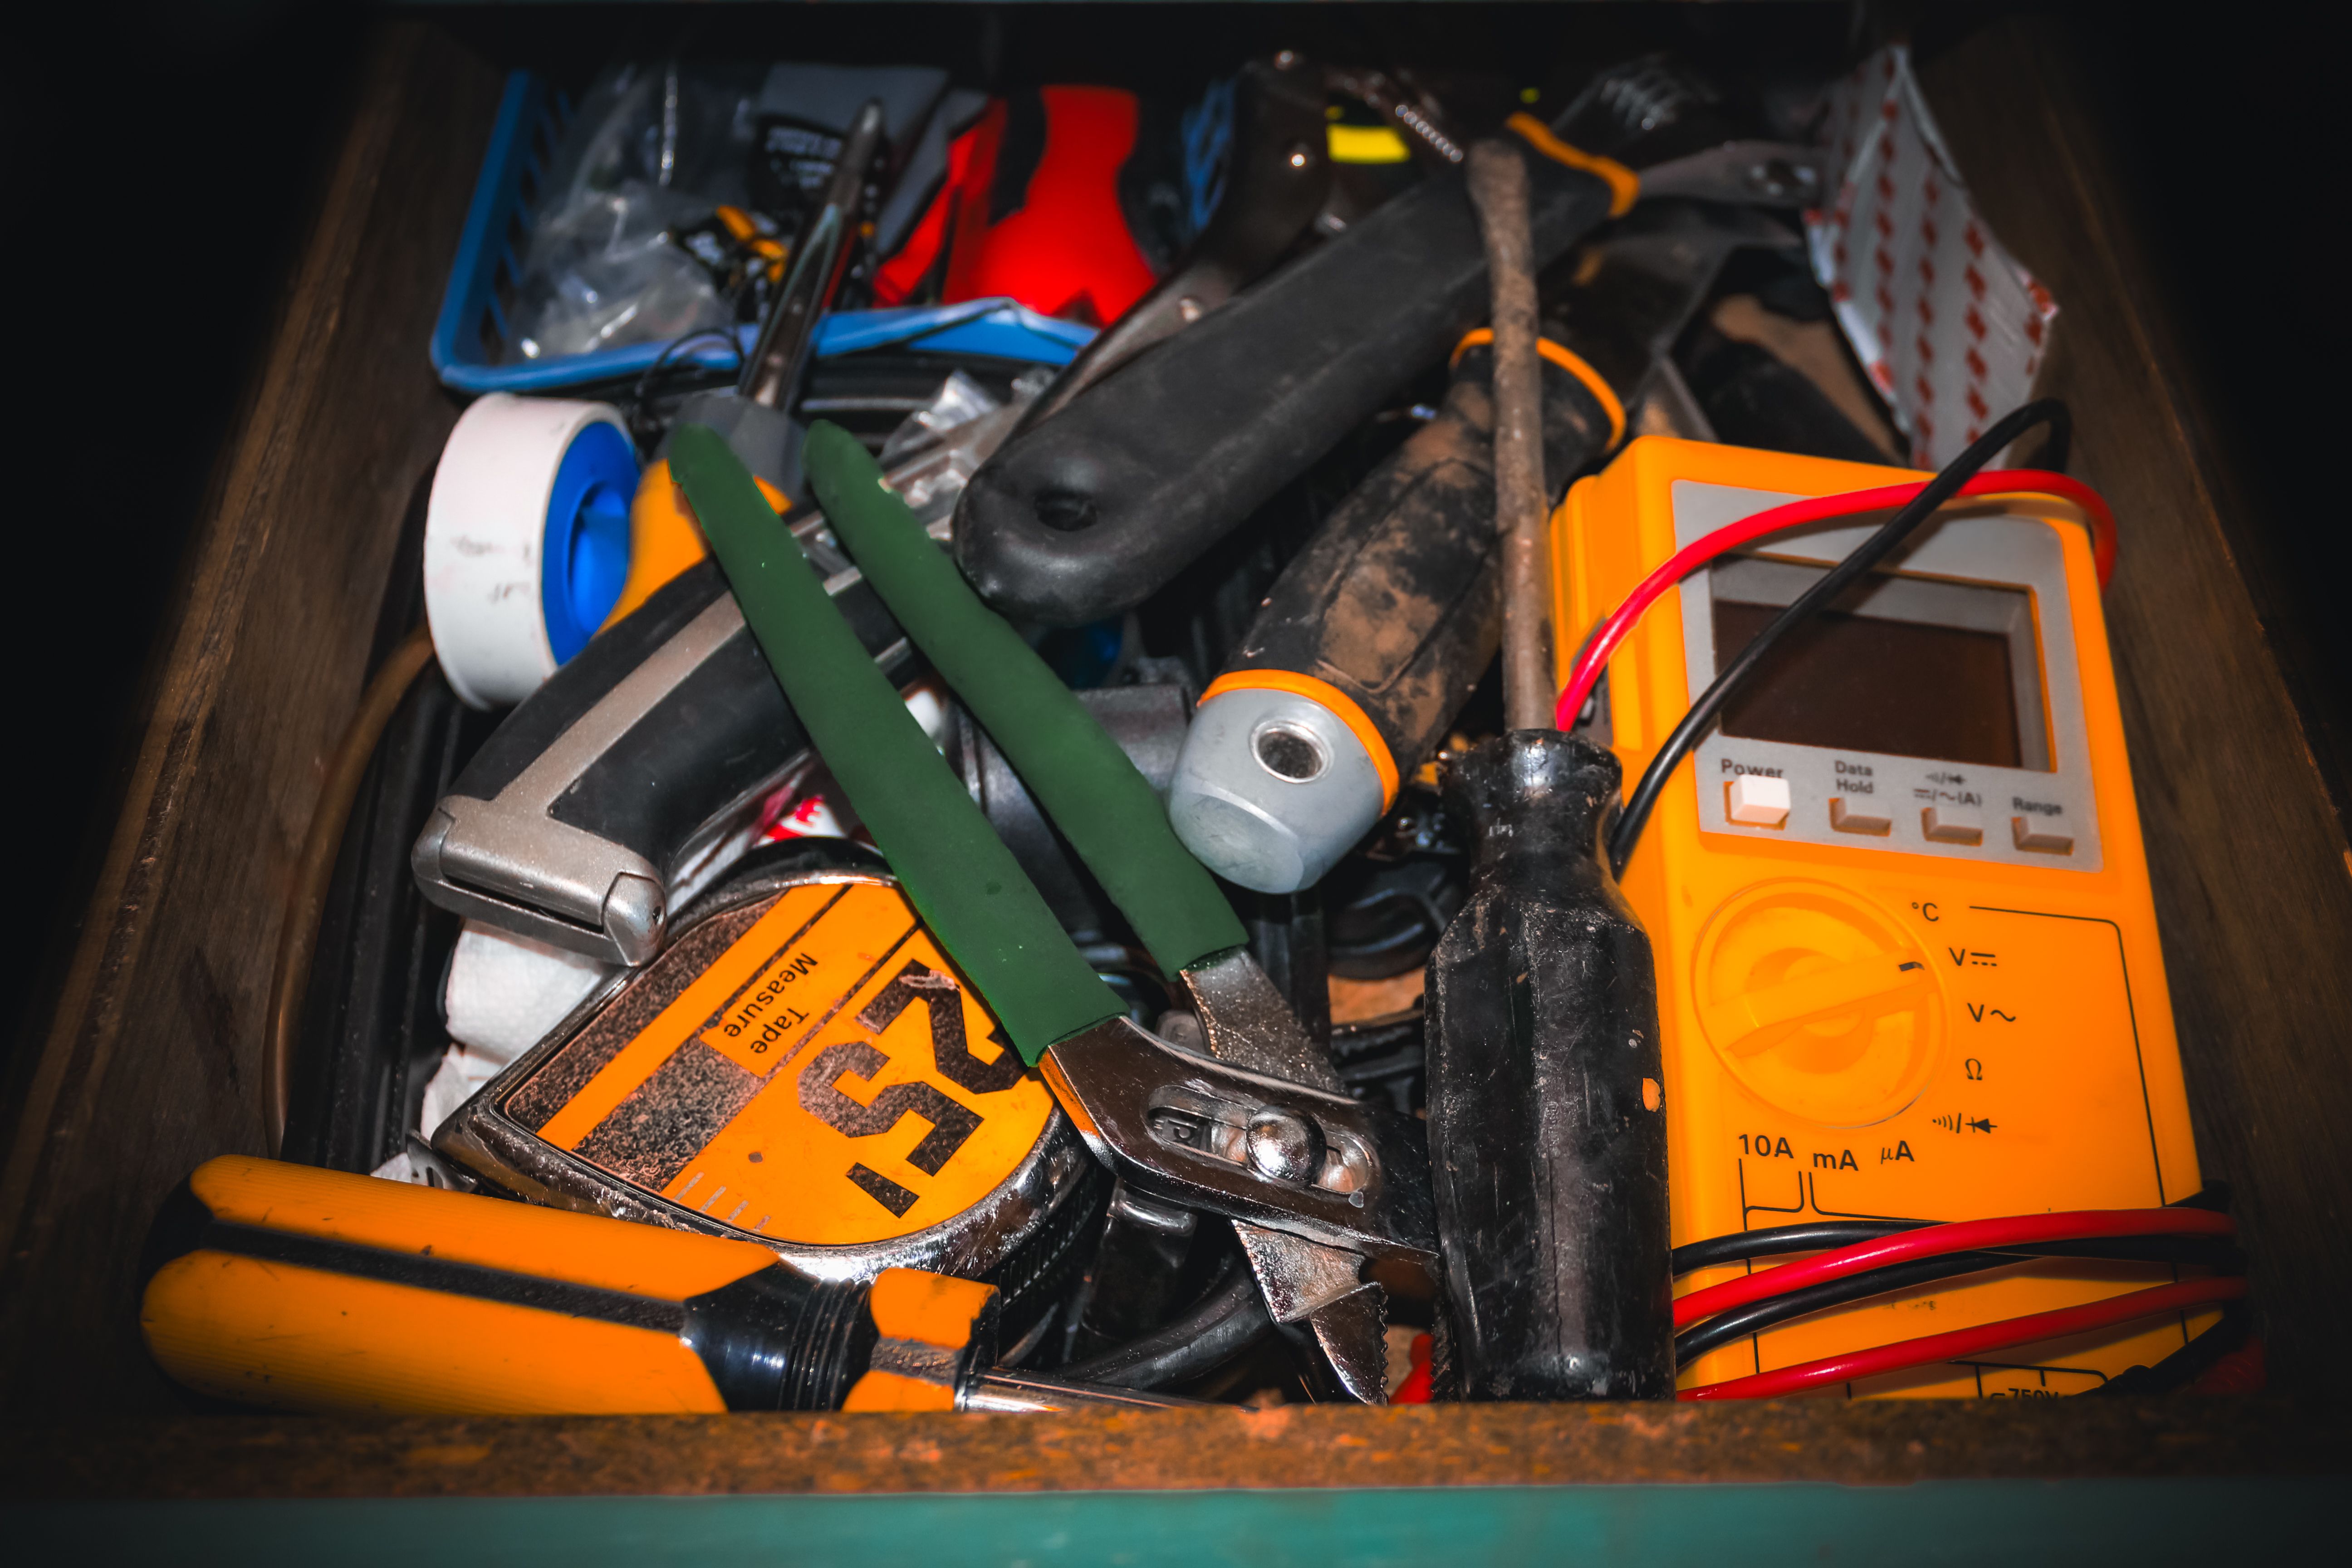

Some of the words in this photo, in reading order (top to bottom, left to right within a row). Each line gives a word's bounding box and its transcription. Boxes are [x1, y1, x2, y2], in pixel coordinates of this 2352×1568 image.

[1720, 758, 1784, 779] Power
[1834, 760, 1873, 776] Data
[1836, 779, 1873, 794] Hold
[2012, 797, 2063, 816] Range
[723, 952, 818, 1037] Measure
[750, 1007, 810, 1054] Tape
[1739, 1134, 1794, 1159] 10A
[1813, 1149, 1859, 1171] mA
